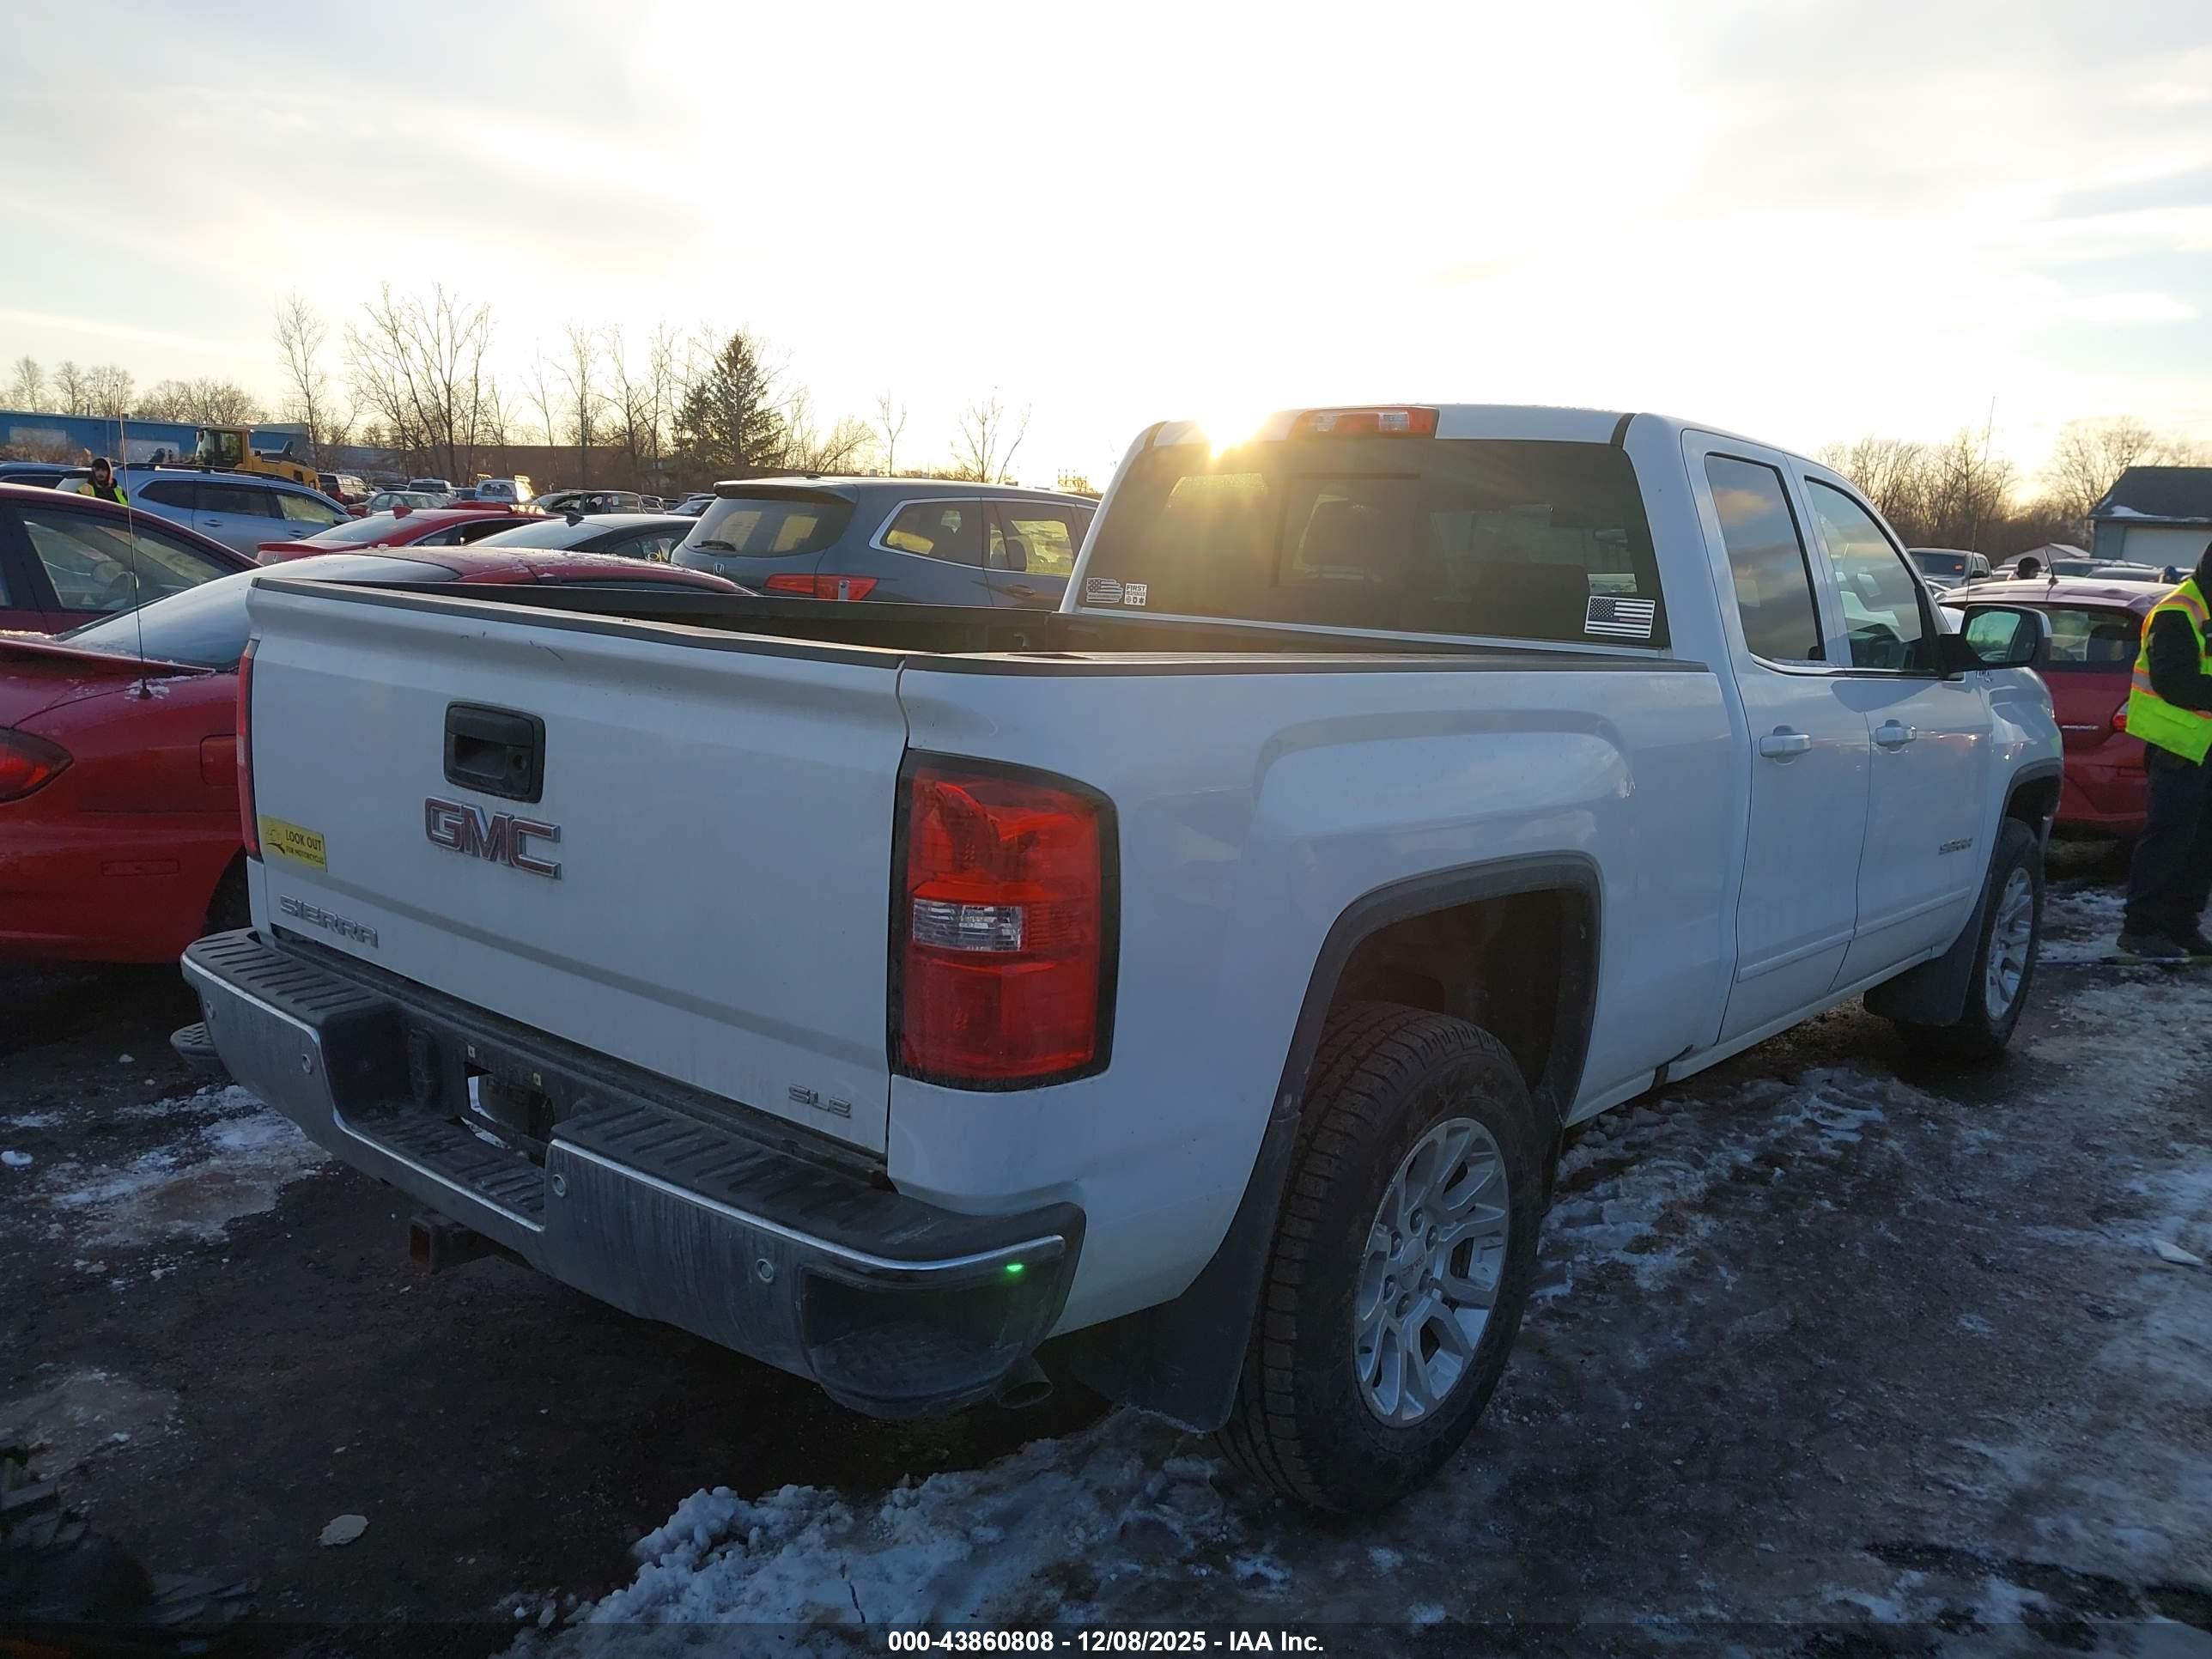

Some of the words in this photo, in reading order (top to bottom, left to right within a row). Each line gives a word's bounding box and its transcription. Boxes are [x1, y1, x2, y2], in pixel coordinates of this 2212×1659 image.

[285, 829, 306, 847] LOOK
[307, 836, 322, 852] OUT
[425, 796, 562, 880] GMC
[280, 894, 379, 949] SIERRA
